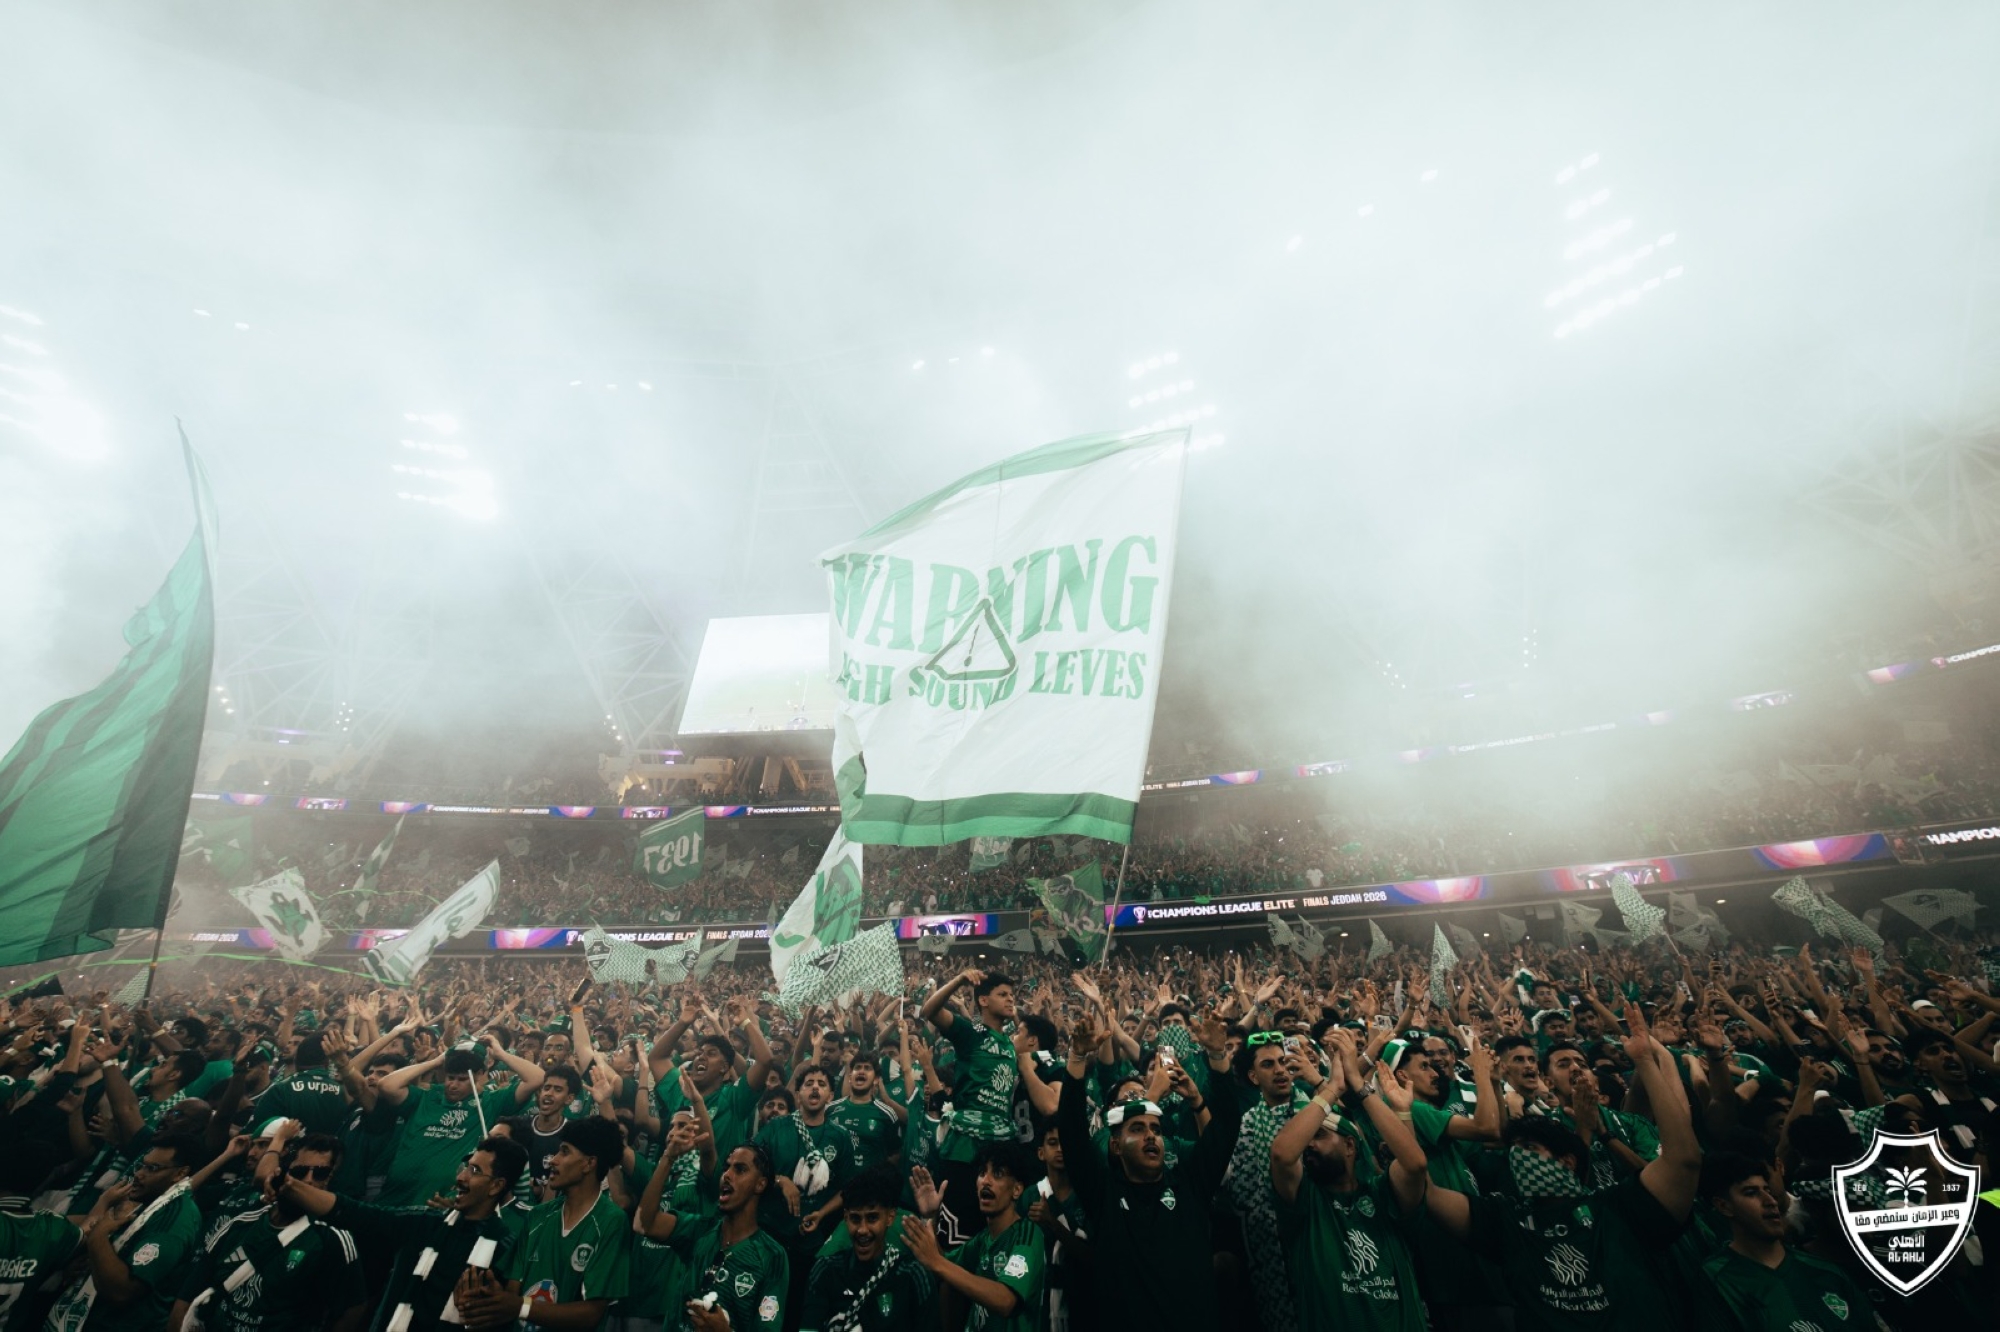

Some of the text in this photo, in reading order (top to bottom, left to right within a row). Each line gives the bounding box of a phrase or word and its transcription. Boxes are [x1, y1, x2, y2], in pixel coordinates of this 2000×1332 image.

[822, 535, 1159, 655] WARNING
[909, 666, 1019, 711] SOUND
[1028, 648, 1146, 700] LEVES
[1153, 905, 1218, 919] CHAMPIONS
[1219, 902, 1263, 914] LEAGUE
[1264, 899, 1295, 911] ELITE
[1303, 896, 1329, 908] FINALS
[1330, 894, 1362, 905] JEDDAH
[193, 932, 218, 942] JEDDAH
[637, 931, 674, 941] LEAGUE
[674, 931, 697, 941] ELIT
[707, 931, 728, 940] FINALS
[307, 1080, 340, 1096] urpay
[1342, 1282, 1359, 1294] Red
[1373, 1289, 1400, 1301] Global
[1561, 1299, 1579, 1311] Sea
